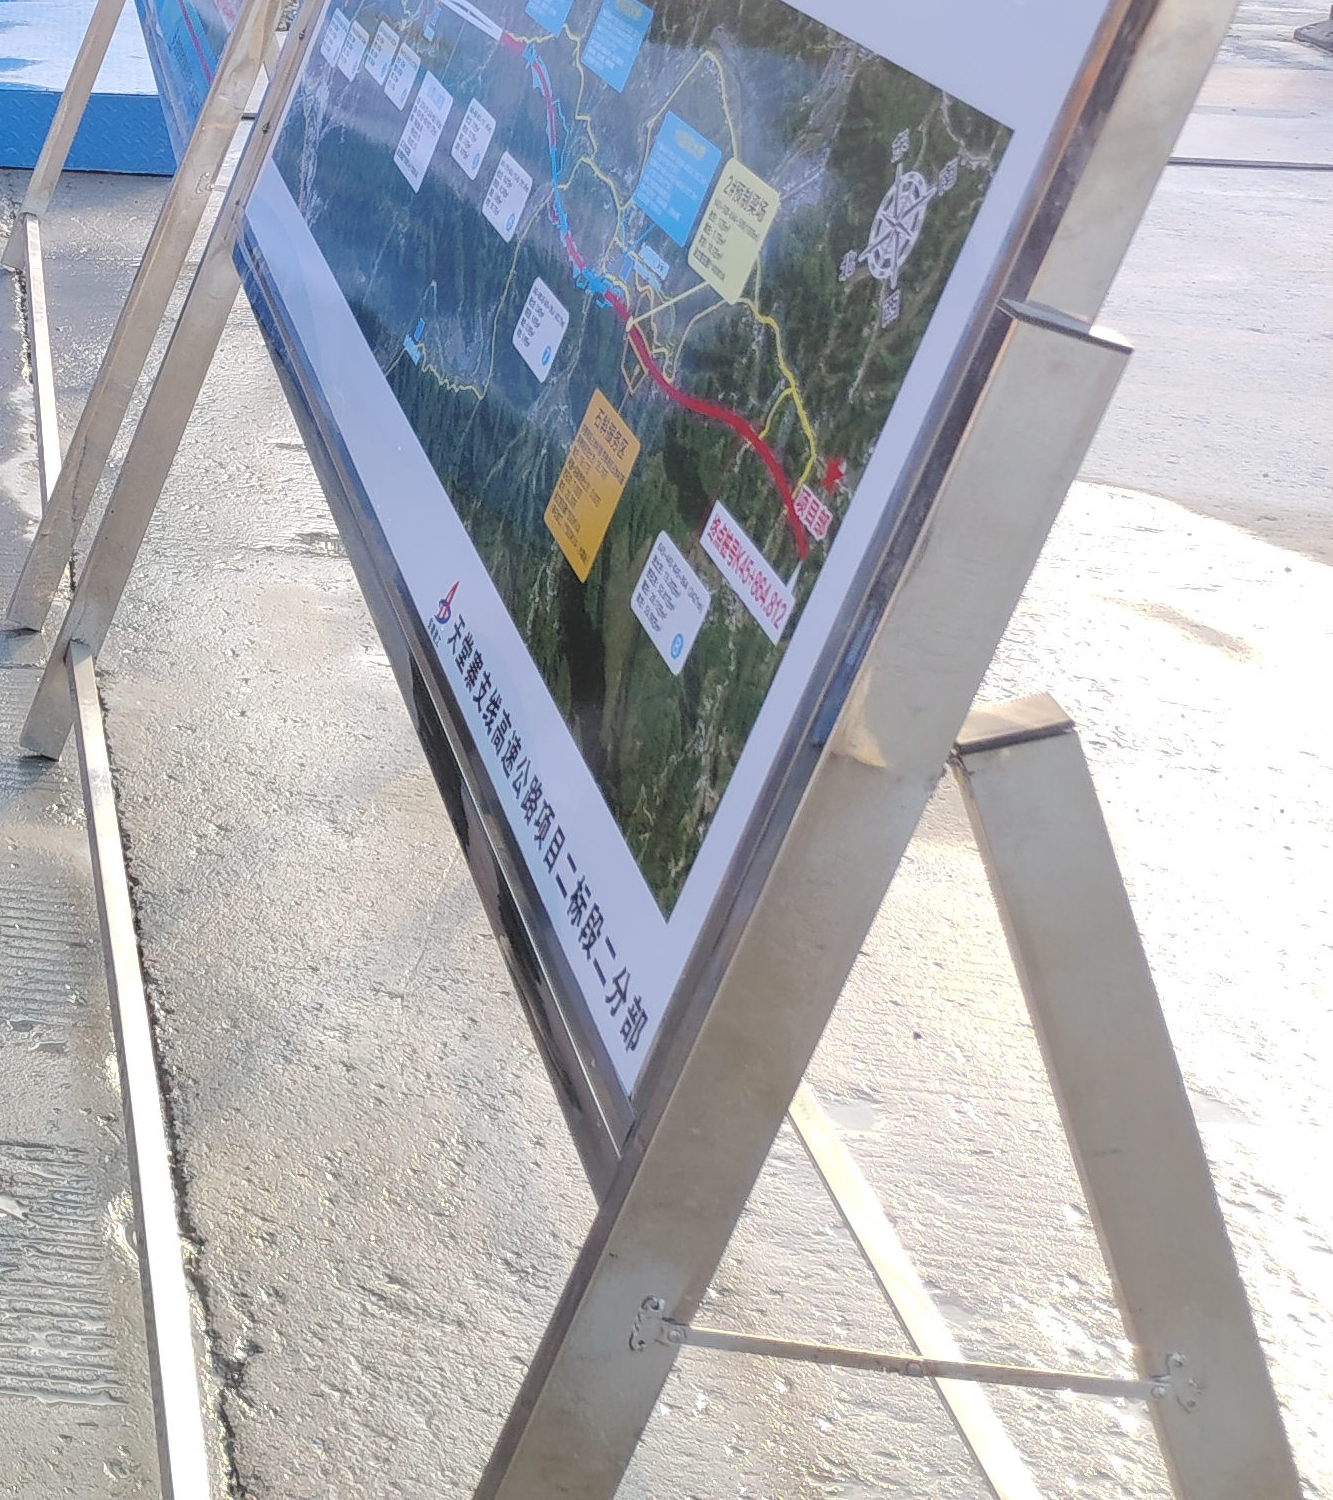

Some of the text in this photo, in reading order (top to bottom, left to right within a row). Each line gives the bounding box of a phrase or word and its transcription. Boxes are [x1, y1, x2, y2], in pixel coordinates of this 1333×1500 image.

[792, 484, 832, 541] 项目部
[445, 615, 652, 1054] 天堂寨支线高速公路项目二标段二分部
